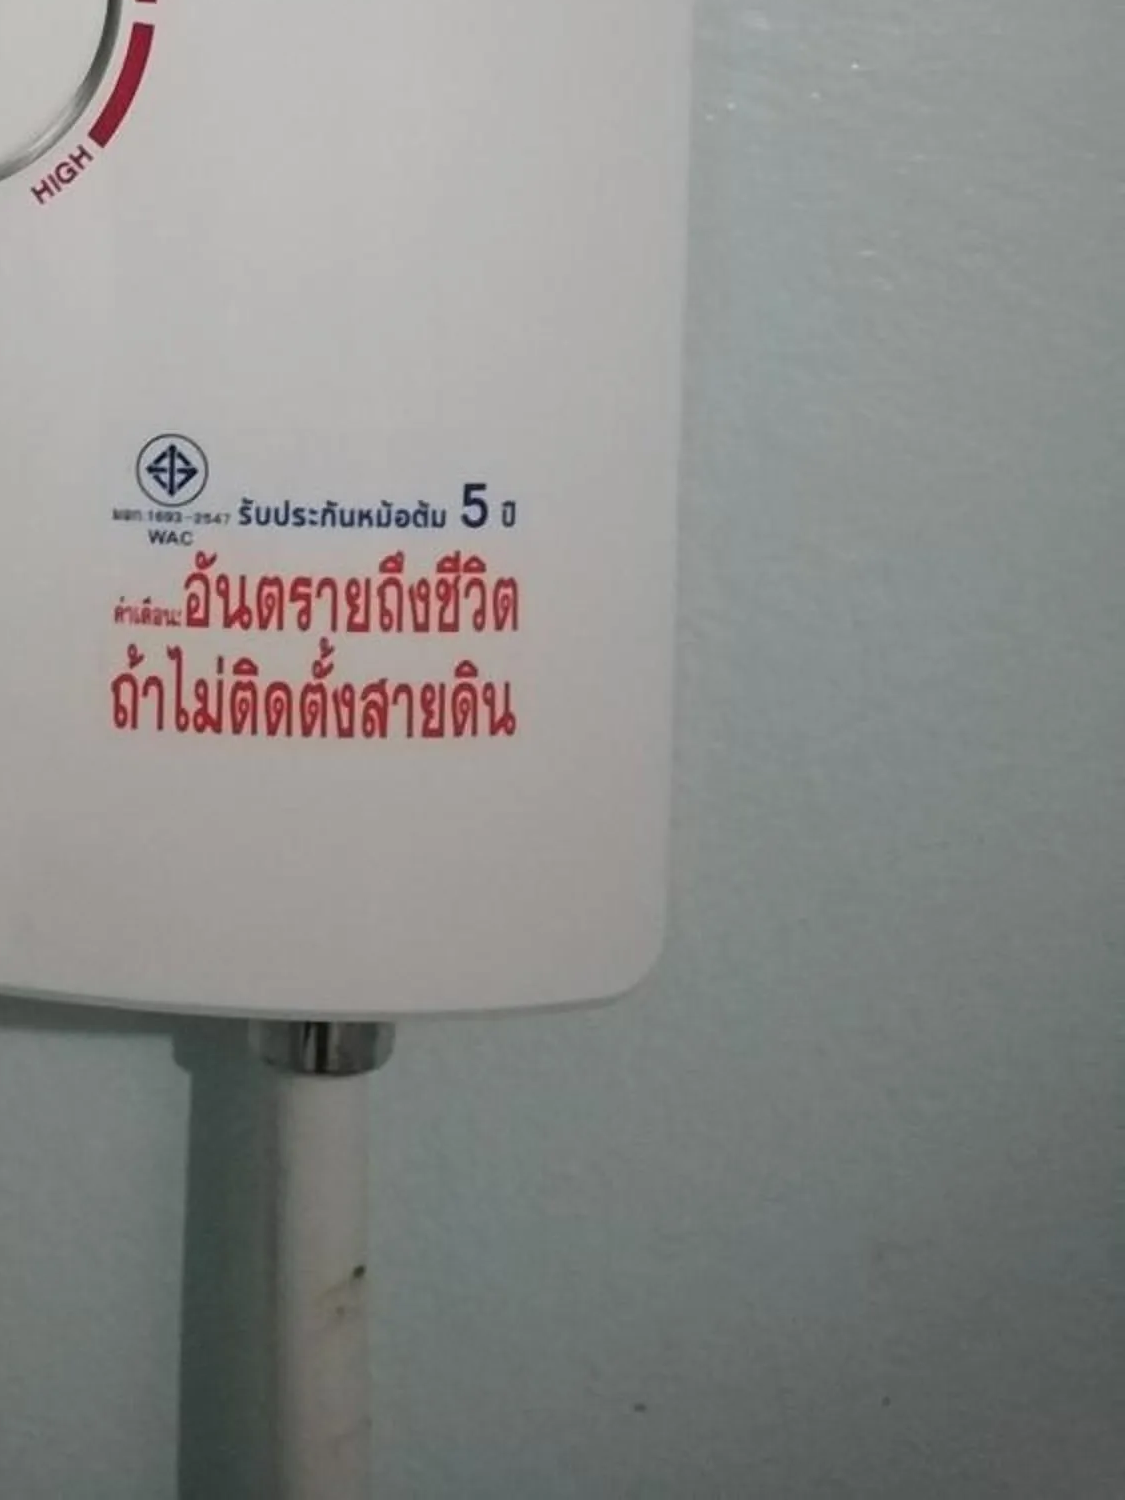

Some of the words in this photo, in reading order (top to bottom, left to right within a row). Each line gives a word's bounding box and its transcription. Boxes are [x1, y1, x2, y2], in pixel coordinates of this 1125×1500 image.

[29, 143, 94, 204] HIGH
[238, 498, 446, 529] รับประกันหม้อต้ม
[461, 482, 488, 529] 5
[501, 500, 517, 528] ปี
[148, 530, 194, 546] WAC
[183, 550, 519, 633] อันตรายถึงชีวิต
[111, 636, 517, 740] ถ้าไม่ติดตั้งสายดิน
